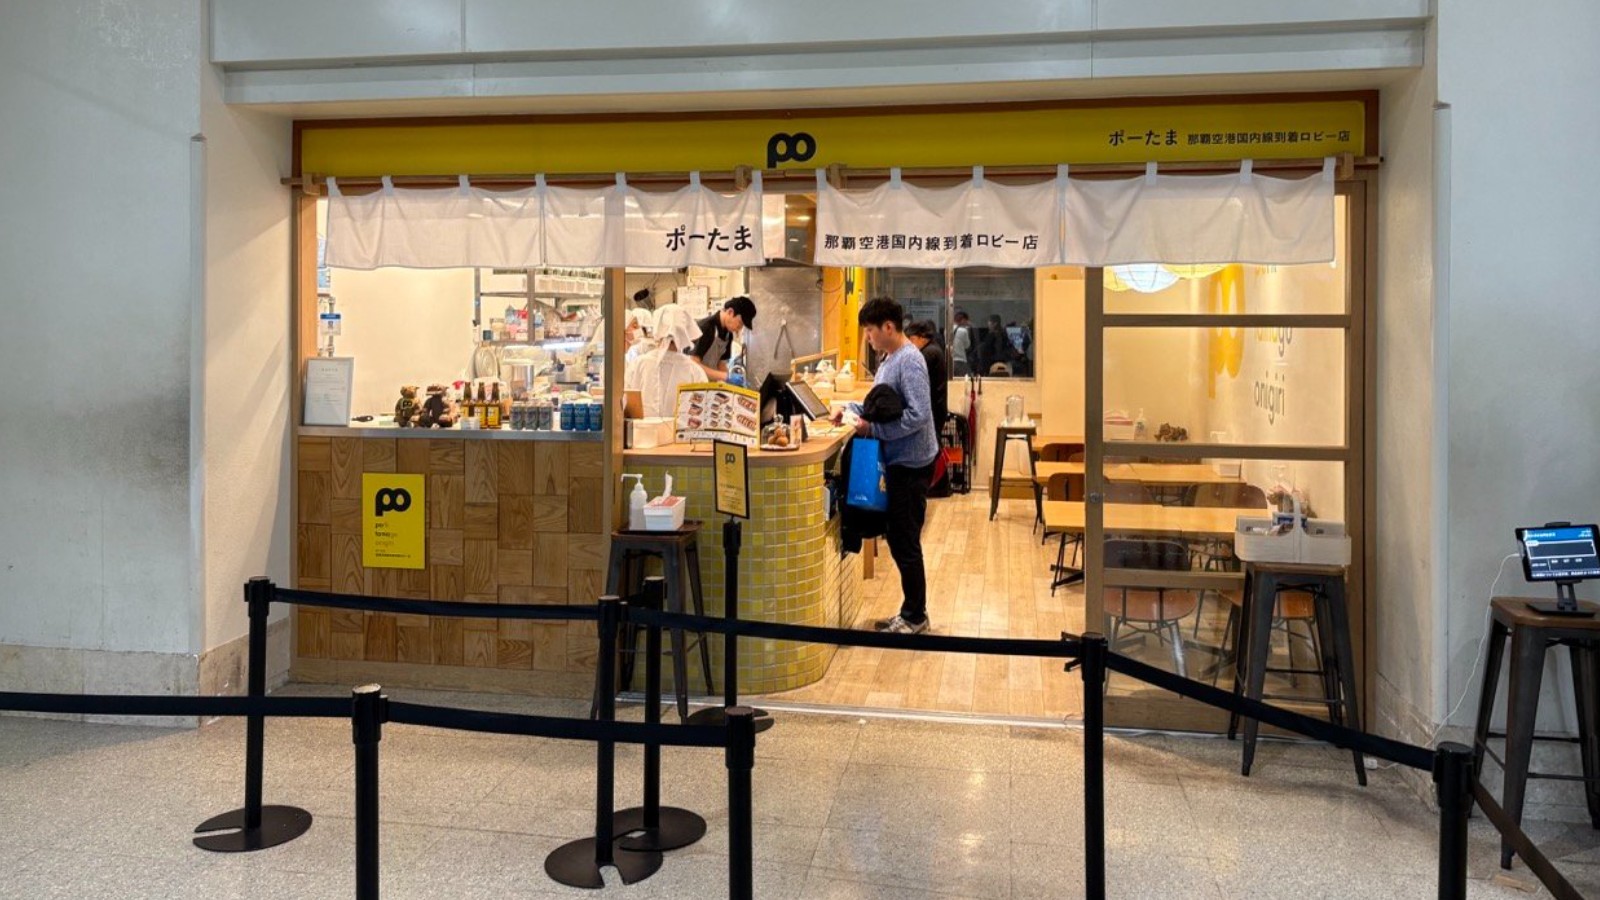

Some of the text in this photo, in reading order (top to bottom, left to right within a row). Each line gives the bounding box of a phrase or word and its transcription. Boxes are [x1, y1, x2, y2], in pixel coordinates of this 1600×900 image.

[766, 132, 817, 169] po
[1108, 129, 1351, 147] ポーたま 那覇空港国内線到着ロビー店
[665, 224, 753, 252] ポーたま
[824, 233, 1039, 251] 那覇空港国内線到着ロビー店
[1254, 370, 1285, 425] onigiri
[375, 487, 412, 517] po
